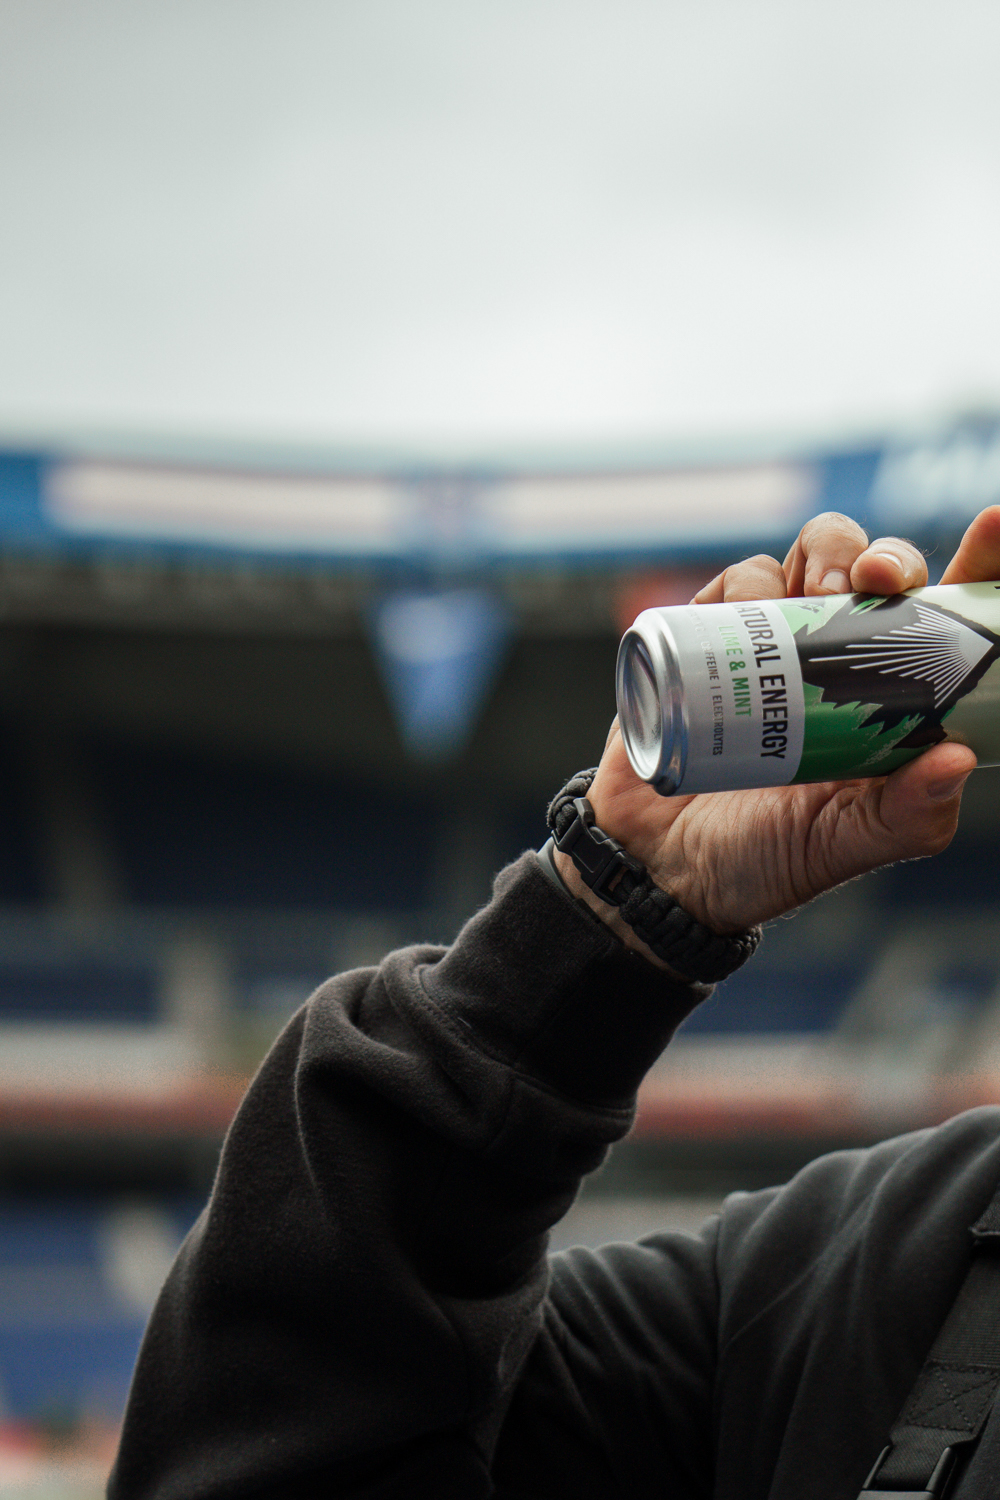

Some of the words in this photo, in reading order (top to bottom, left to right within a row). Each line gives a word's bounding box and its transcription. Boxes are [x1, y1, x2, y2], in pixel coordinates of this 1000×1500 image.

[717, 625, 744, 656] LIME
[729, 660, 746, 672] &
[731, 602, 781, 668] NATURAL
[759, 674, 788, 759] ENERGY
[732, 677, 752, 717] MINT
[712, 695, 724, 756] ELECTROLYTES
